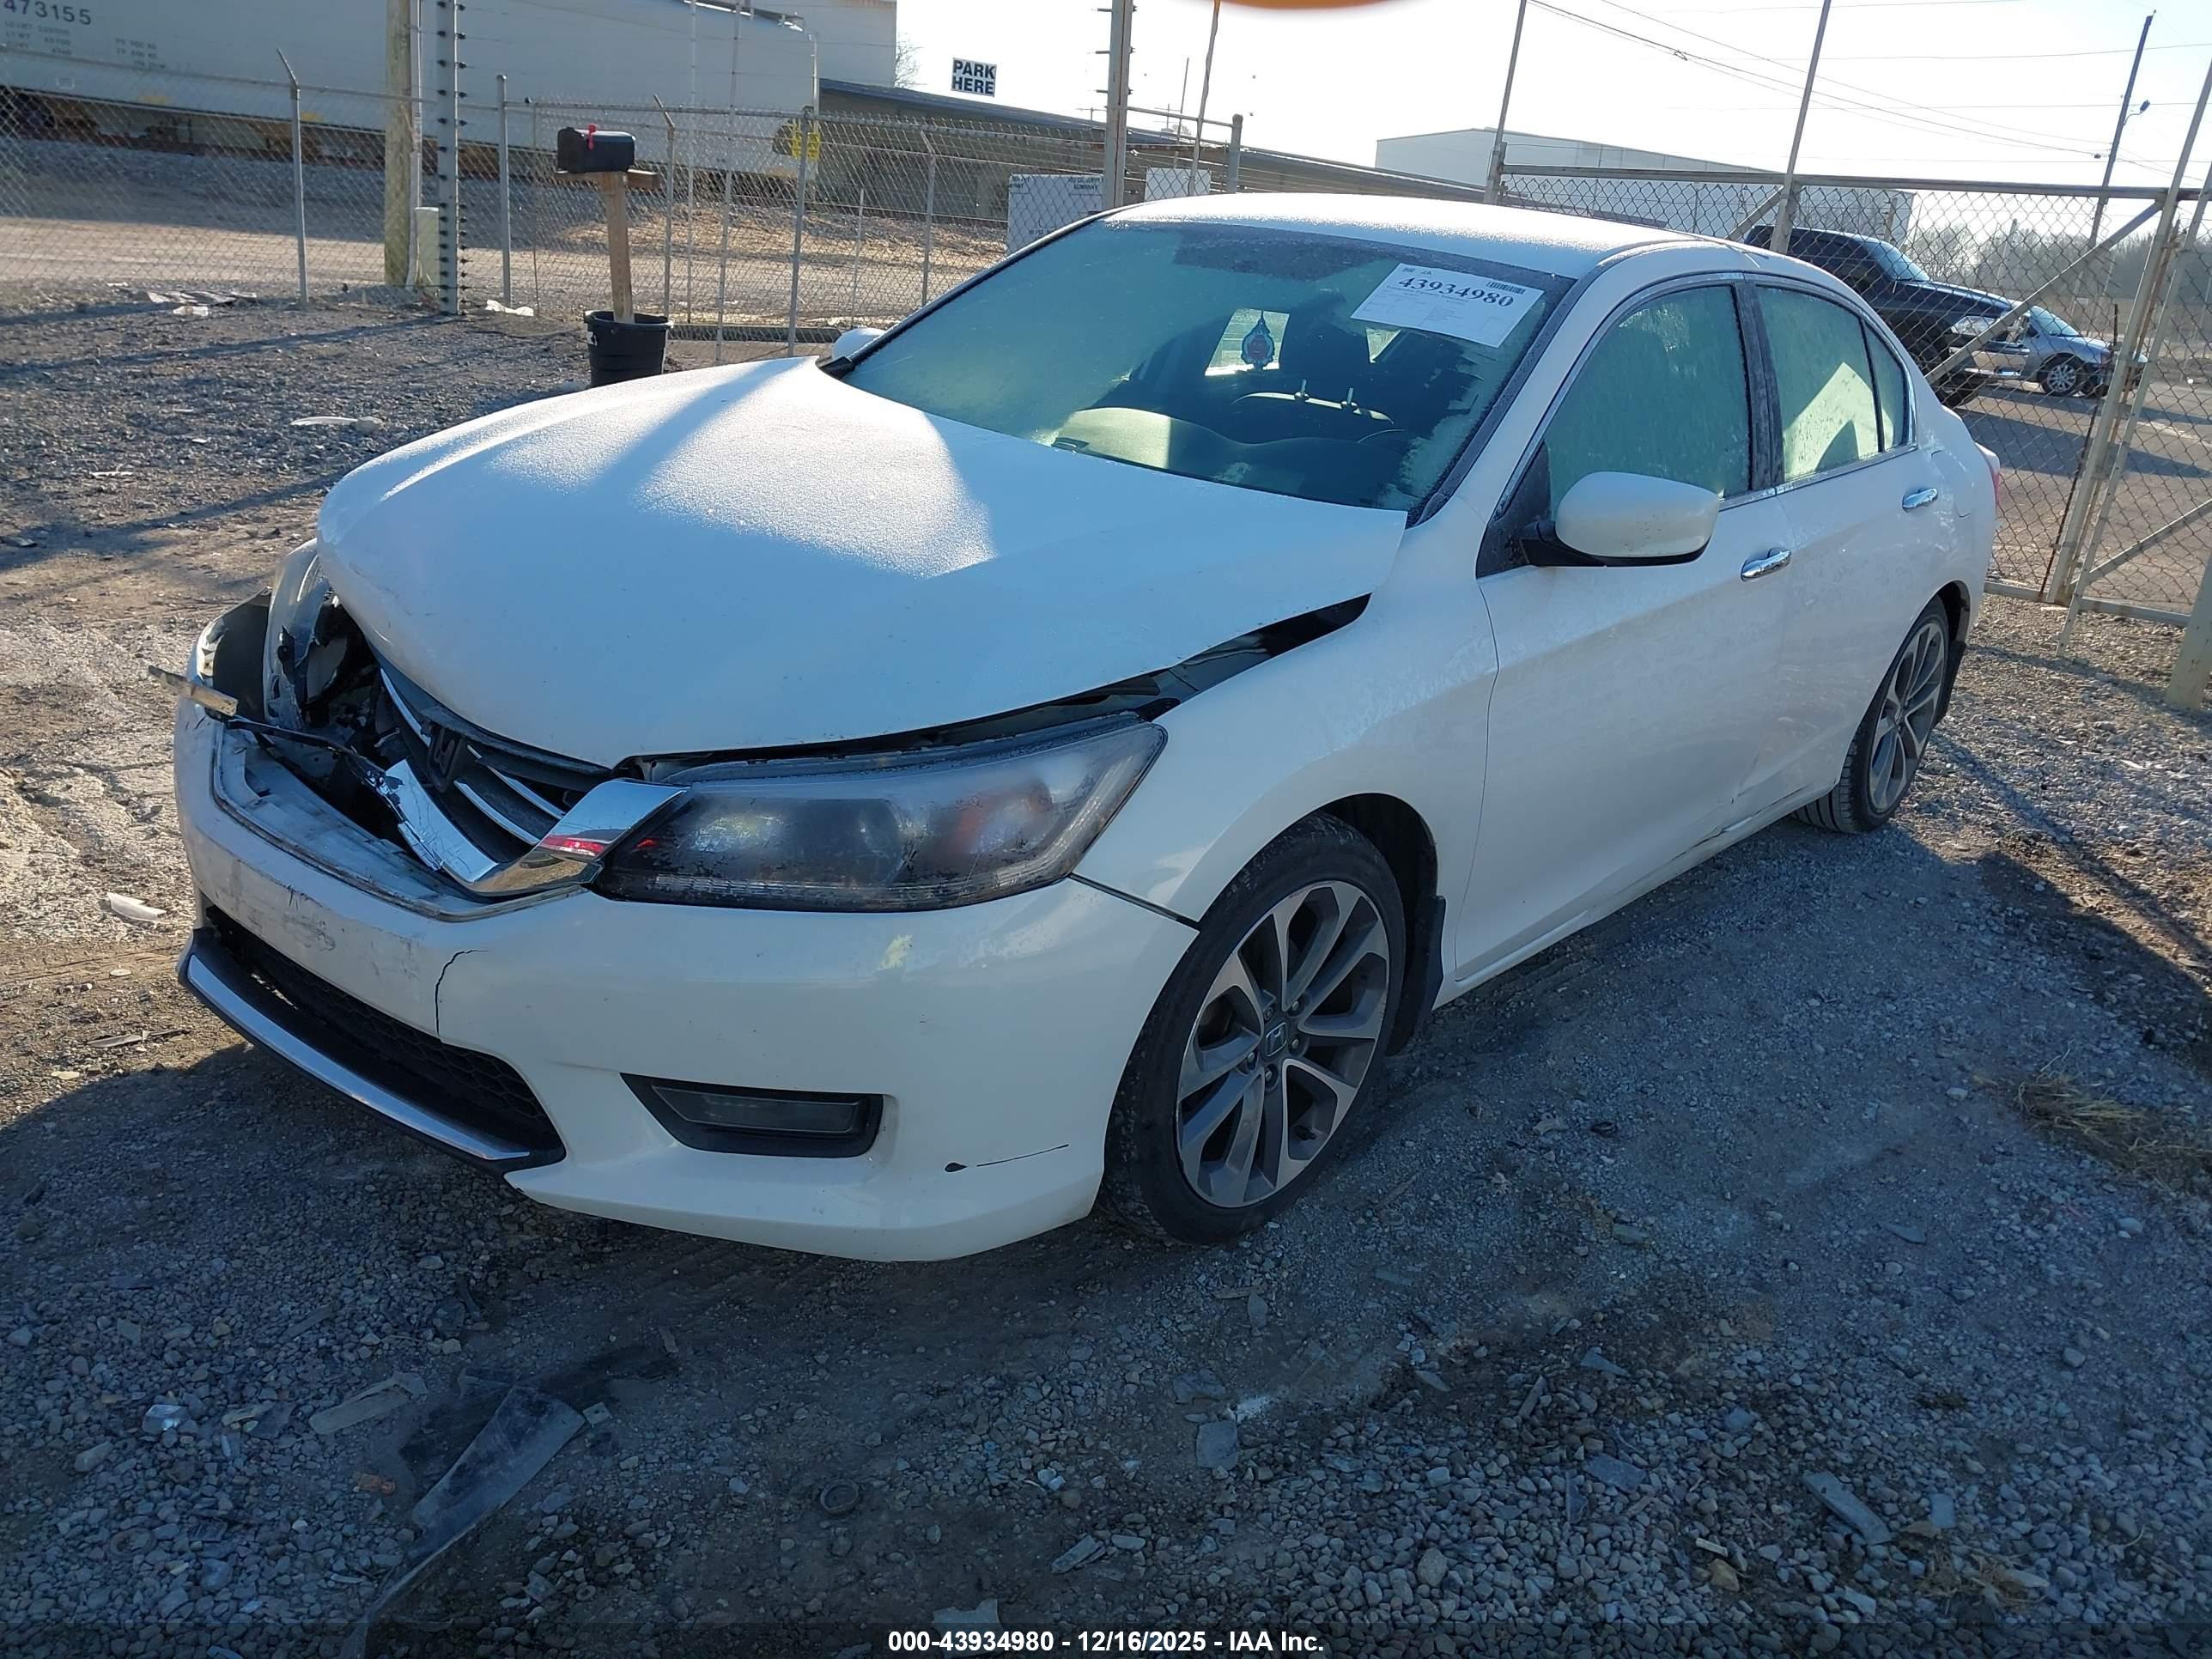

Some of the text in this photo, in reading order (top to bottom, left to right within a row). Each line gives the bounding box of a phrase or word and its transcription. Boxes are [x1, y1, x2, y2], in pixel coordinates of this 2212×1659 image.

[3, 0, 92, 25] 473155
[953, 59, 996, 80] PARK
[951, 76, 994, 94] HERE
[1398, 277, 1515, 307] 43934980
